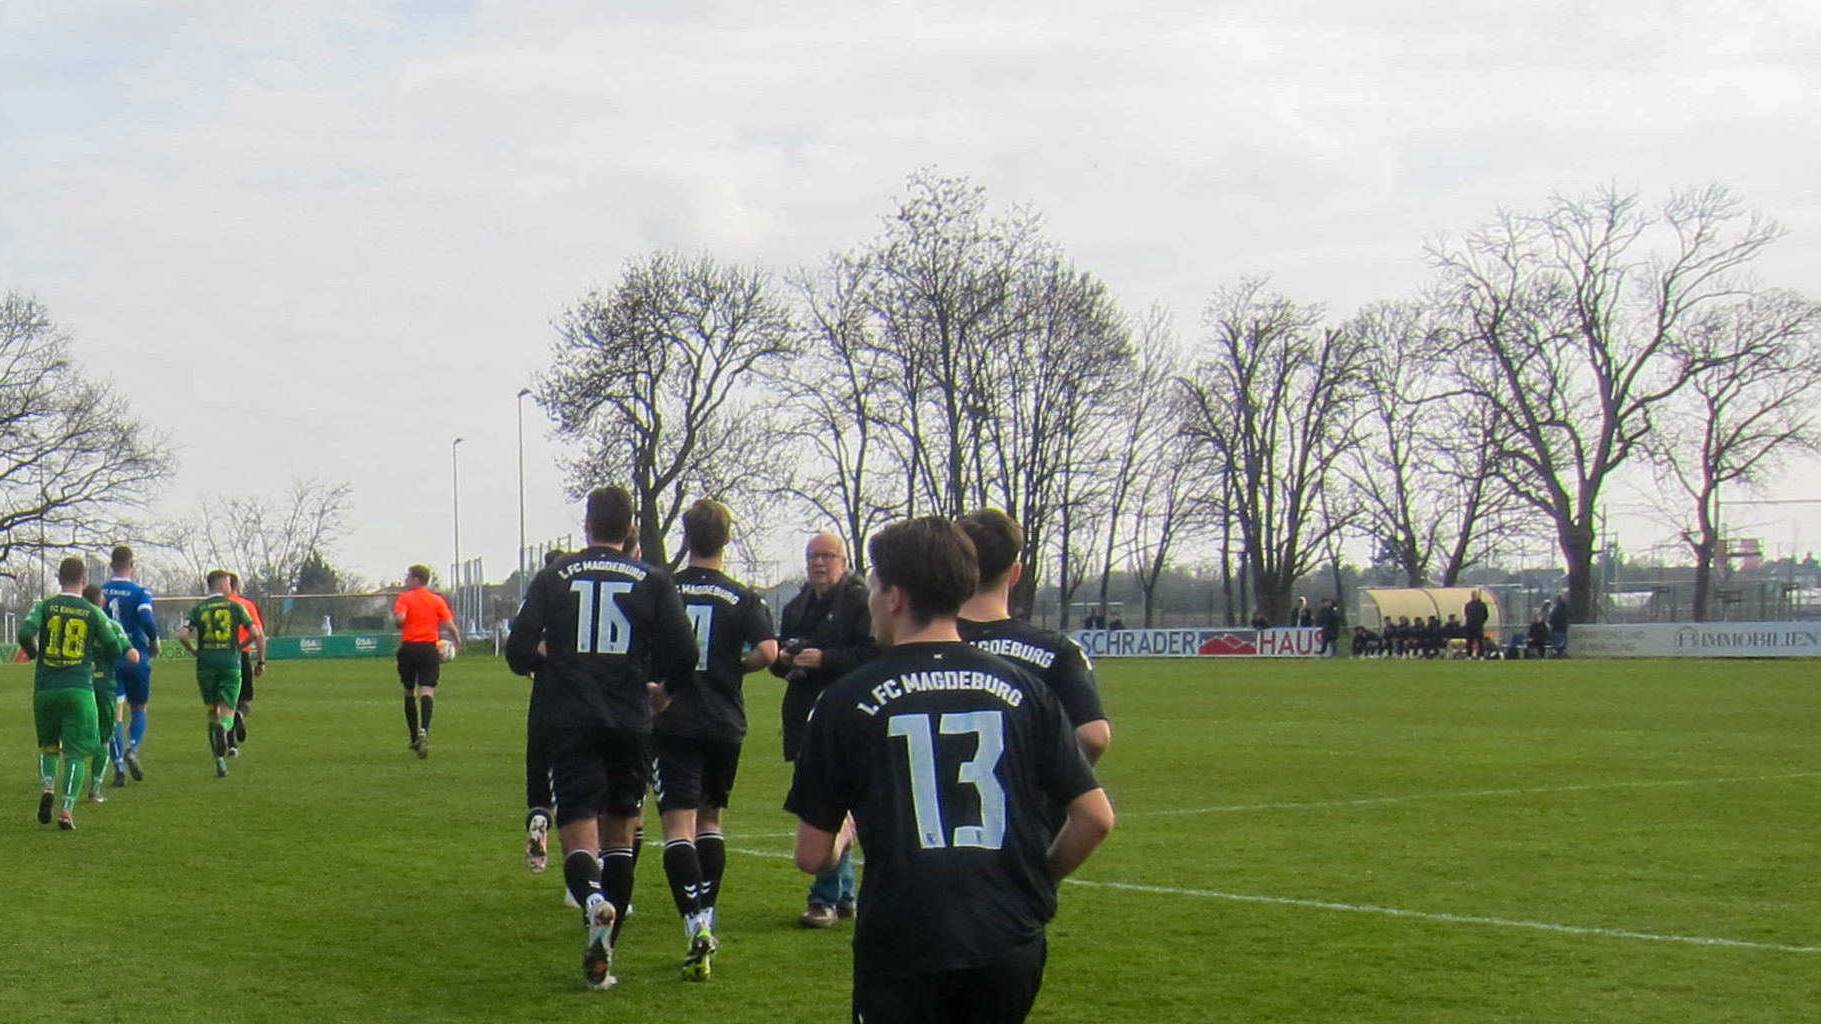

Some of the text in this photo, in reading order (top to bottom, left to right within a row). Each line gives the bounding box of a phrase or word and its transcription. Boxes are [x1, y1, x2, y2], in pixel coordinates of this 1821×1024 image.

[567, 561, 582, 575] FC
[582, 560, 647, 582] MAGDEBURG
[201, 609, 232, 641] 13
[570, 580, 634, 655] 16
[45, 615, 88, 659] 18
[970, 639, 1055, 668] GDEBURG
[1080, 630, 1325, 656] SCHRADER HAUS
[871, 679, 903, 706] FC
[899, 670, 1024, 708] MAGDEBURG
[887, 710, 1007, 851] 13
